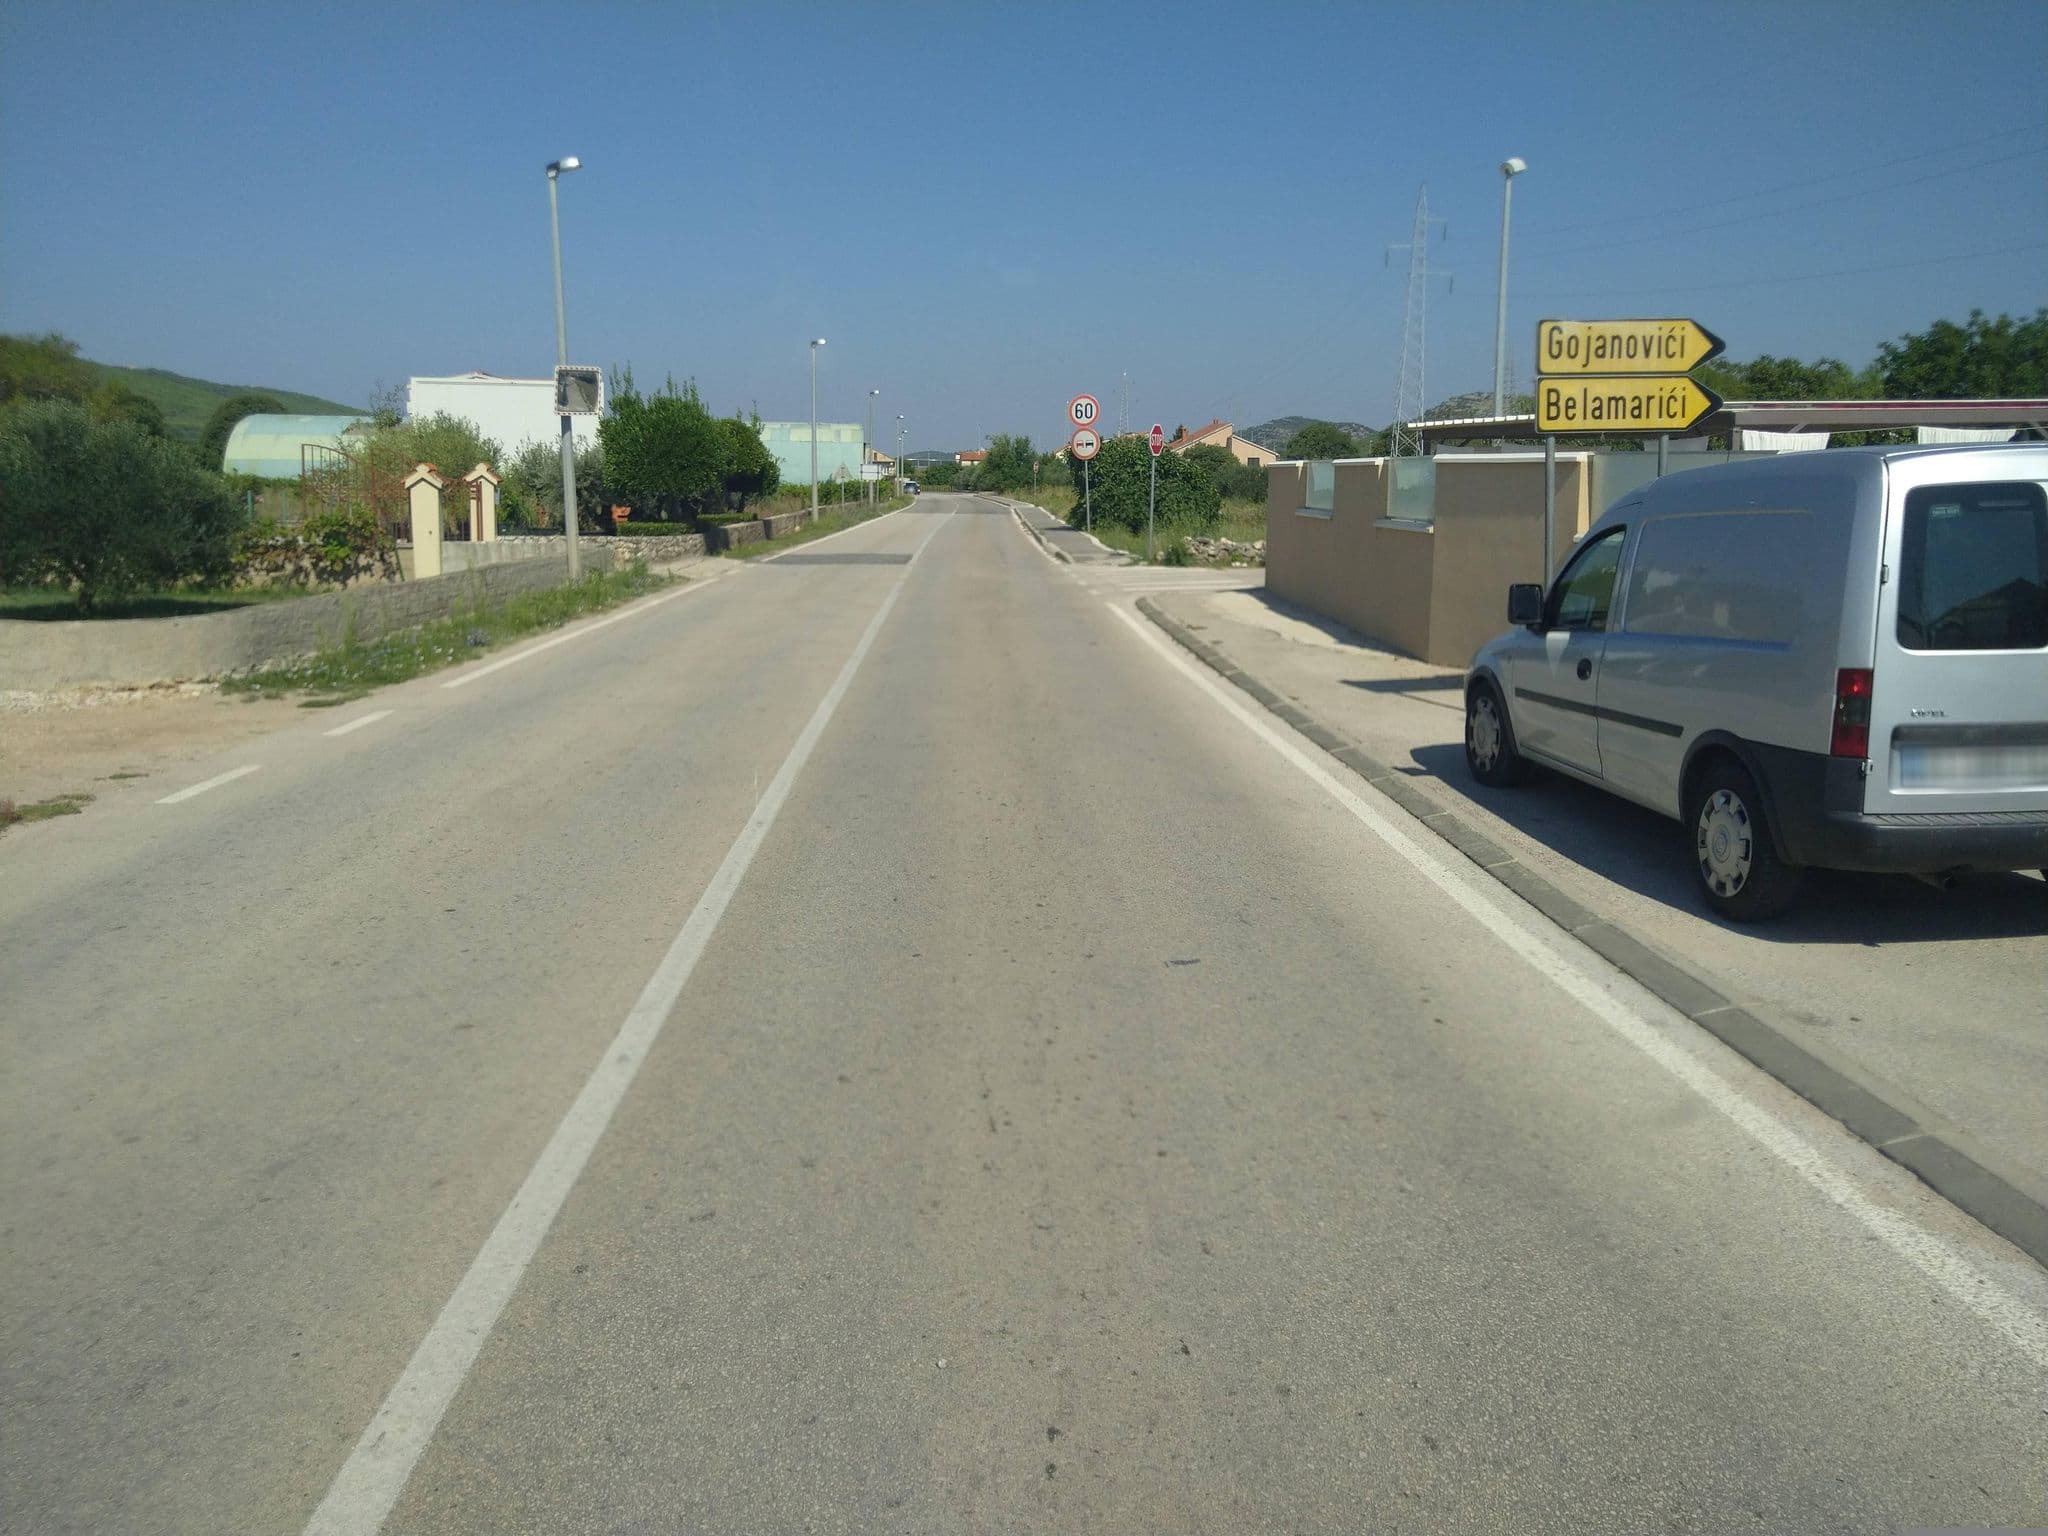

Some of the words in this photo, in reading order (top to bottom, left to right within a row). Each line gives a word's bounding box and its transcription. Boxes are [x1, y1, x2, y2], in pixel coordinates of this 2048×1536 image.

[1547, 325, 1685, 368] Gojanovići
[1075, 403, 1093, 419] 60
[1546, 386, 1686, 421] Belamarići
[1151, 434, 1163, 446] STOP
